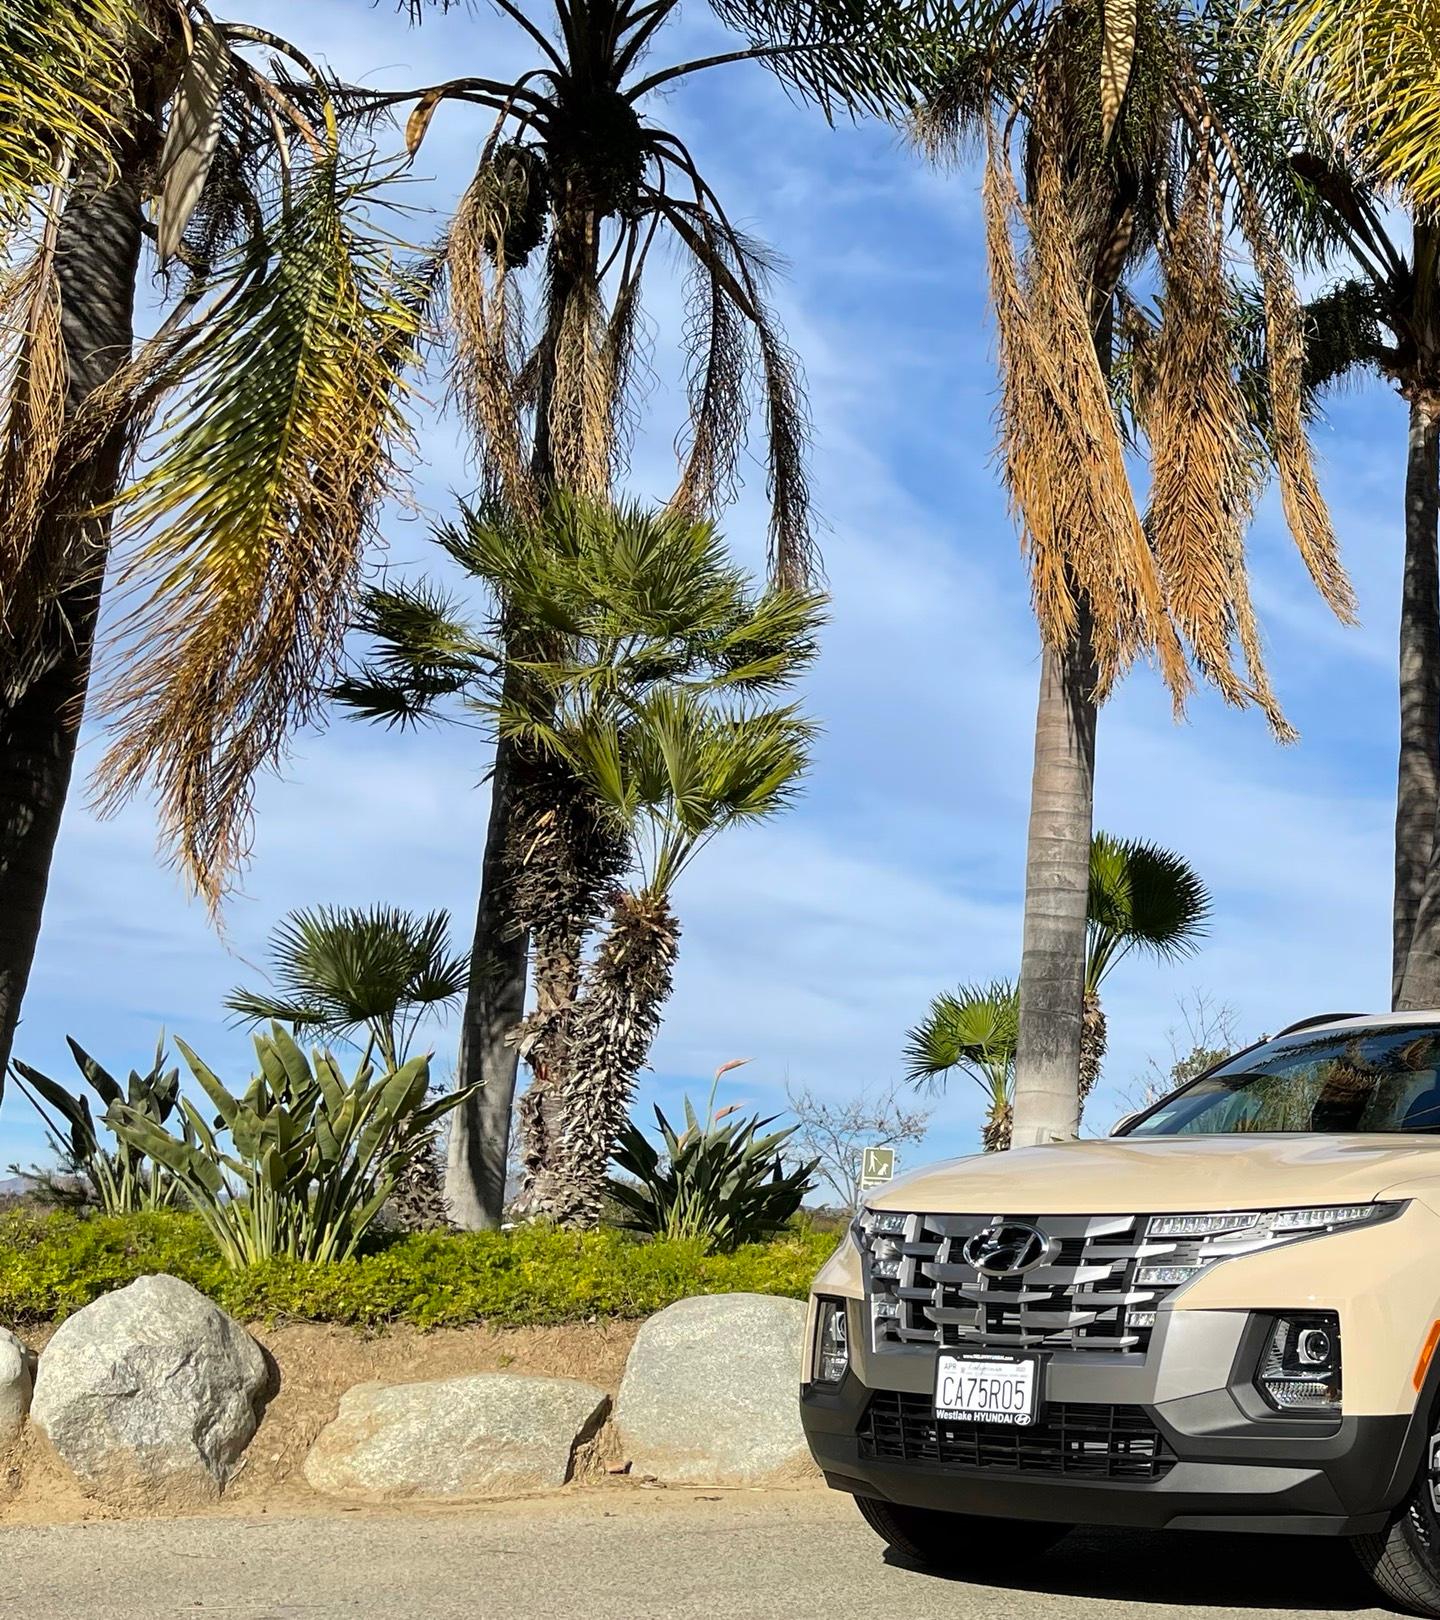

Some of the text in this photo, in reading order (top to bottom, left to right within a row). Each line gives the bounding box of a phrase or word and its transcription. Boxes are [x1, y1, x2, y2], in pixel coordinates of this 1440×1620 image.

[944, 1362, 957, 1370] APR
[942, 1376, 1026, 1410] CA75R05
[936, 1409, 1013, 1424] Westlake HYUNDAI
